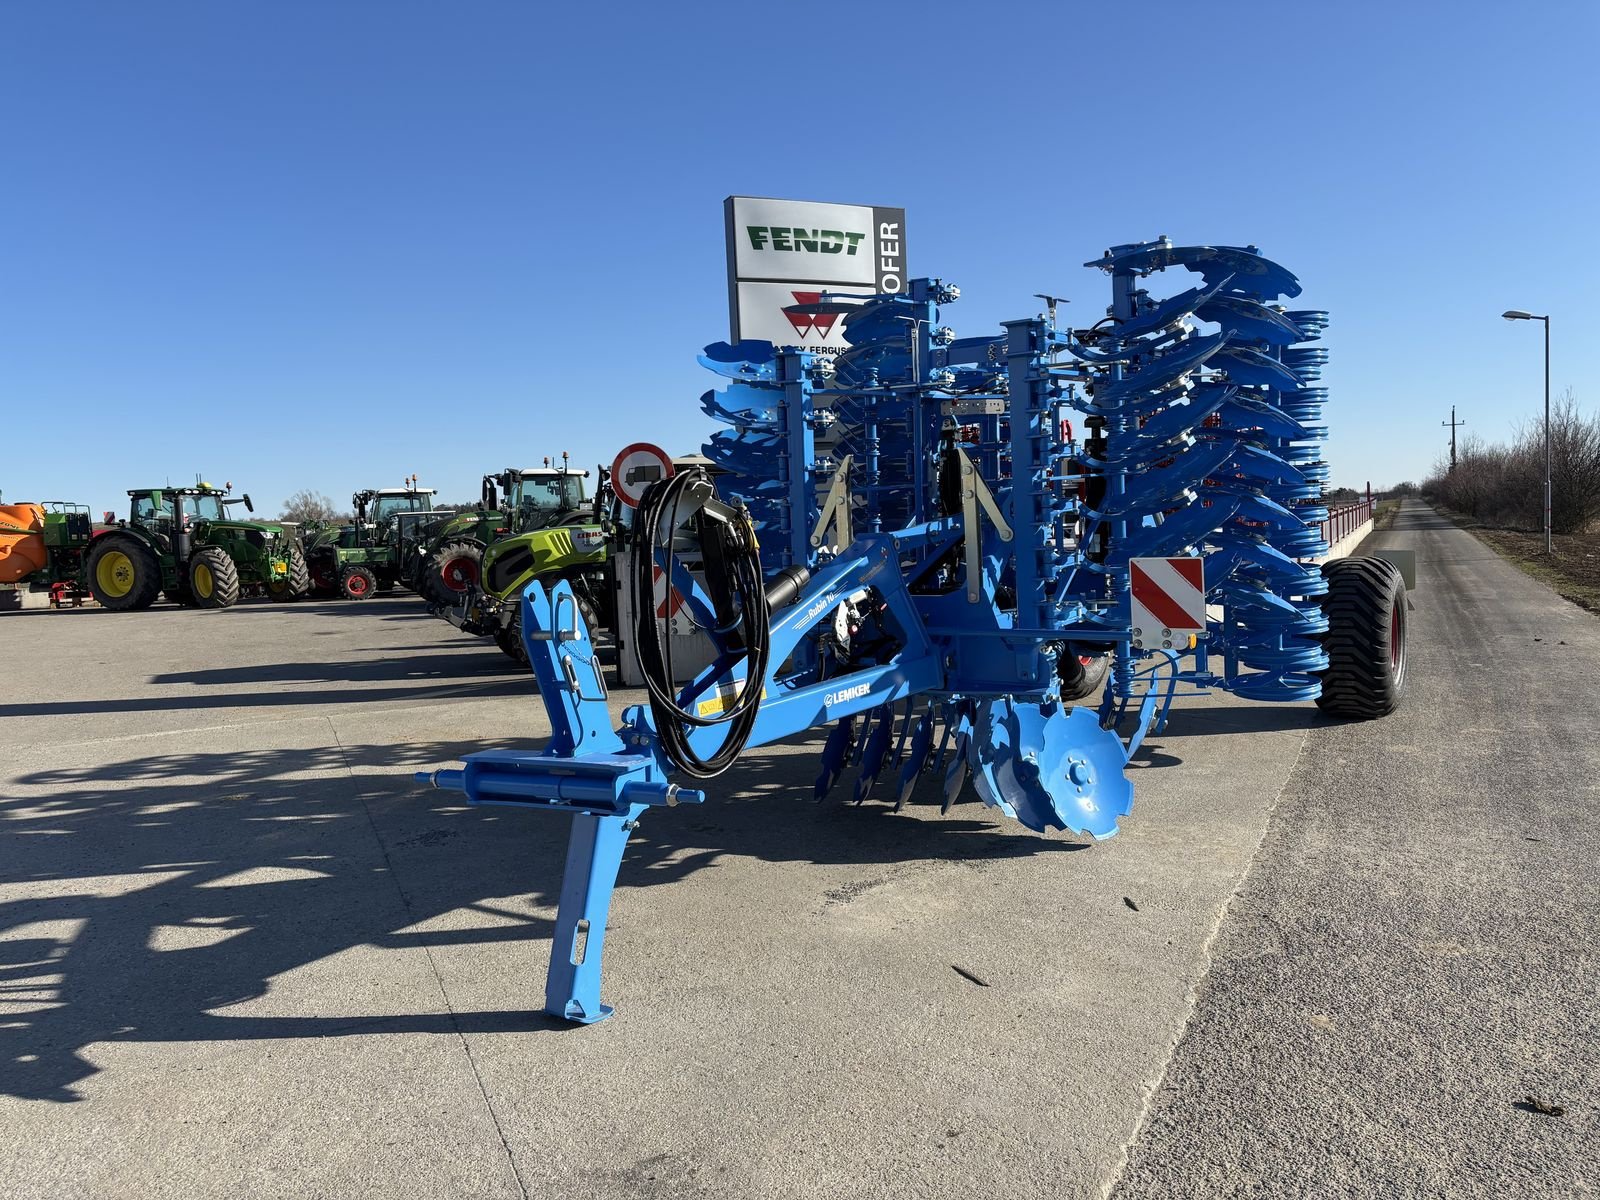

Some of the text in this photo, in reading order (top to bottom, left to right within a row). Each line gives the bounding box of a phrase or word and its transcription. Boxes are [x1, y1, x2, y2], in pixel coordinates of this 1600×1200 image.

[746, 226, 865, 256] FENDT
[880, 222, 901, 294] OFER
[810, 346, 847, 355] FERGUS
[808, 591, 835, 620] Rubin 10
[833, 682, 871, 704] LEMKEN
